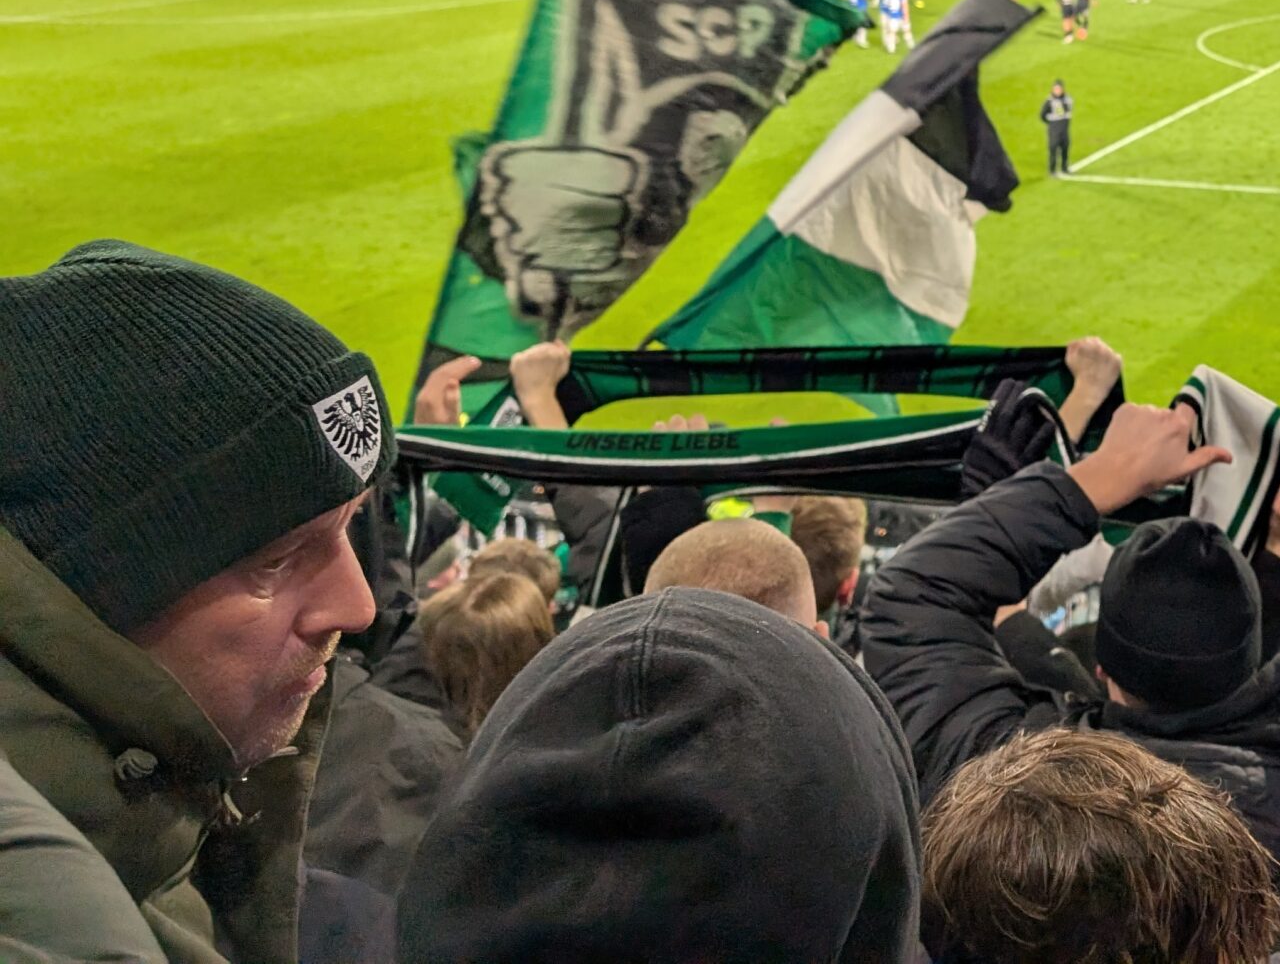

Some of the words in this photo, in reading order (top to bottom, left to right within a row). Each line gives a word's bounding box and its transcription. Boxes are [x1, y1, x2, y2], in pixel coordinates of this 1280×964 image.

[657, 3, 775, 59] SCP
[565, 432, 663, 452] UNSERE
[671, 431, 742, 452] LIEBE
